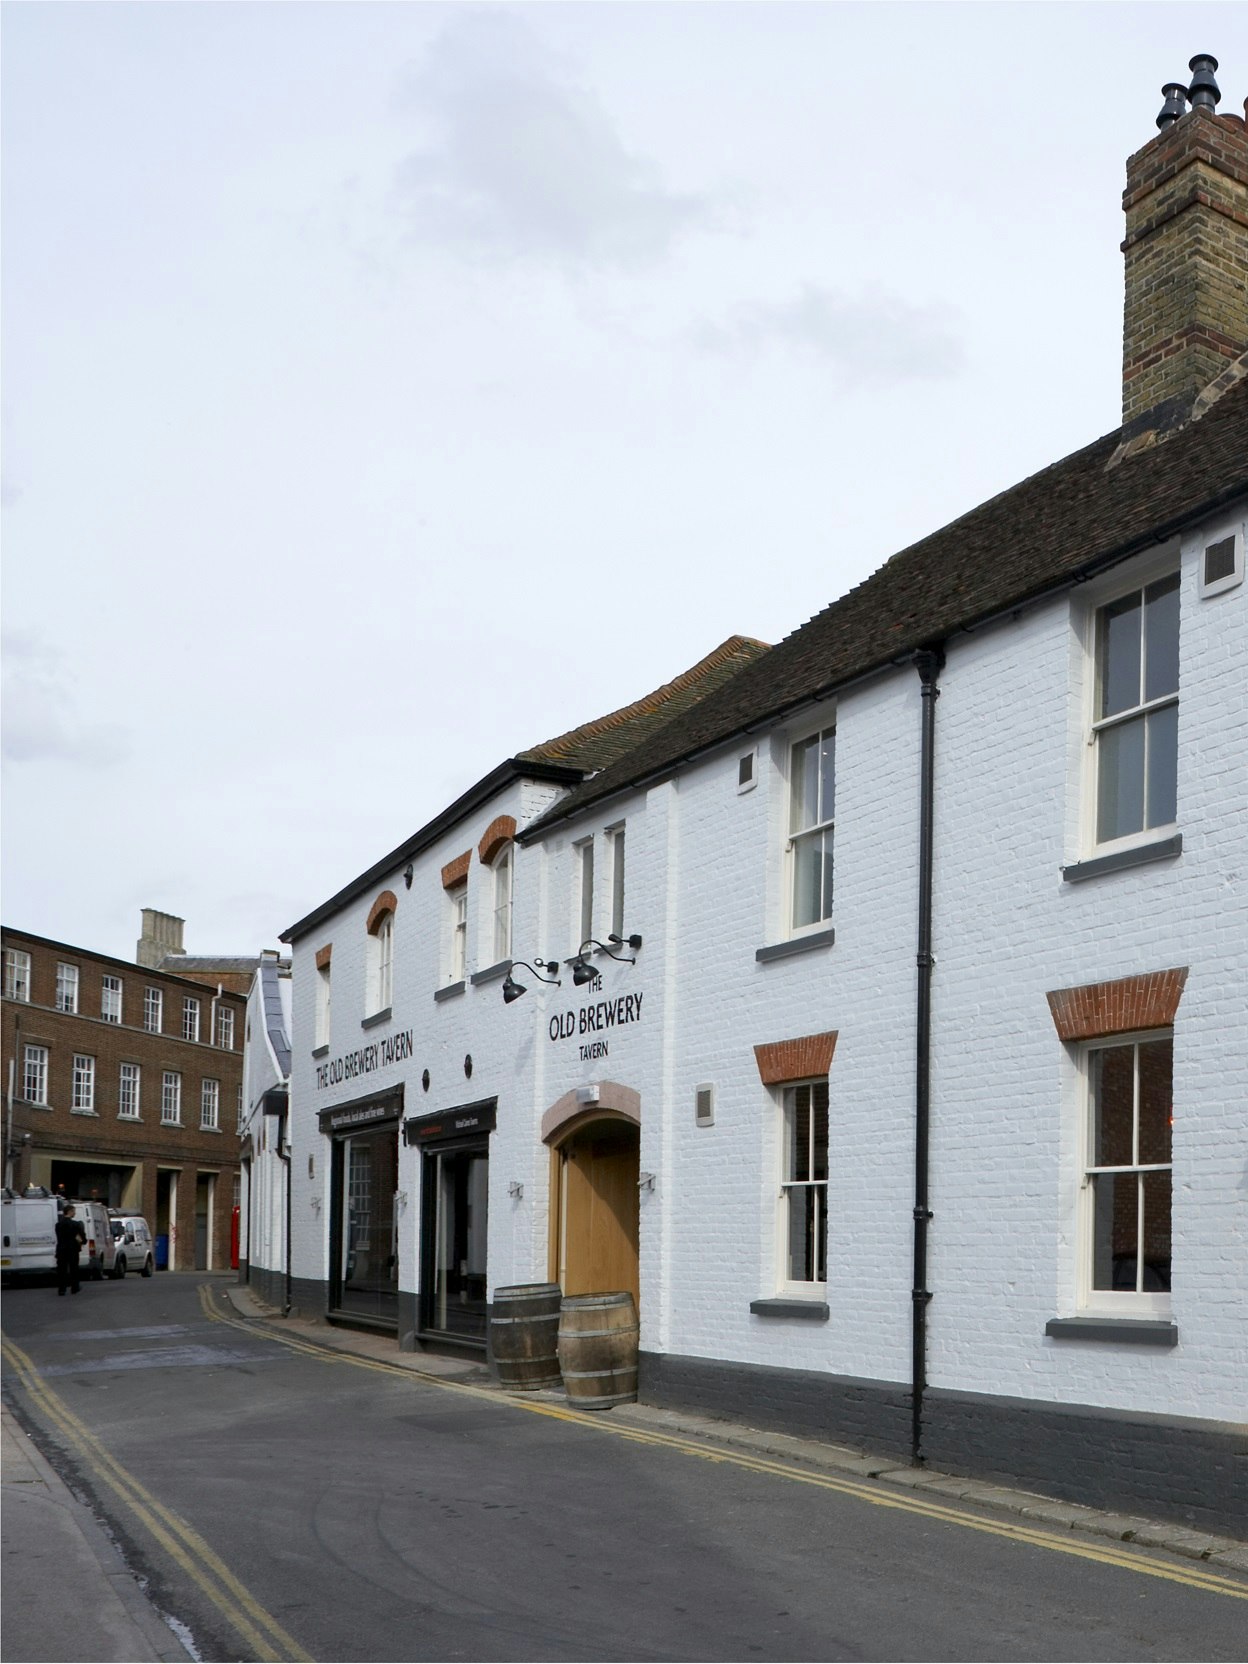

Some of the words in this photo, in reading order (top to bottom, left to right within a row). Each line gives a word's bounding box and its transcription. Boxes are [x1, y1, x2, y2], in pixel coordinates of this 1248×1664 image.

[549, 1011, 576, 1041] OLD
[579, 992, 643, 1035] BREWERY
[316, 1064, 329, 1091] THE
[329, 1057, 344, 1085] OLD
[344, 1042, 379, 1080] BREWERY
[381, 1028, 413, 1067] TAVERN
[579, 1040, 609, 1061] TAVERN
